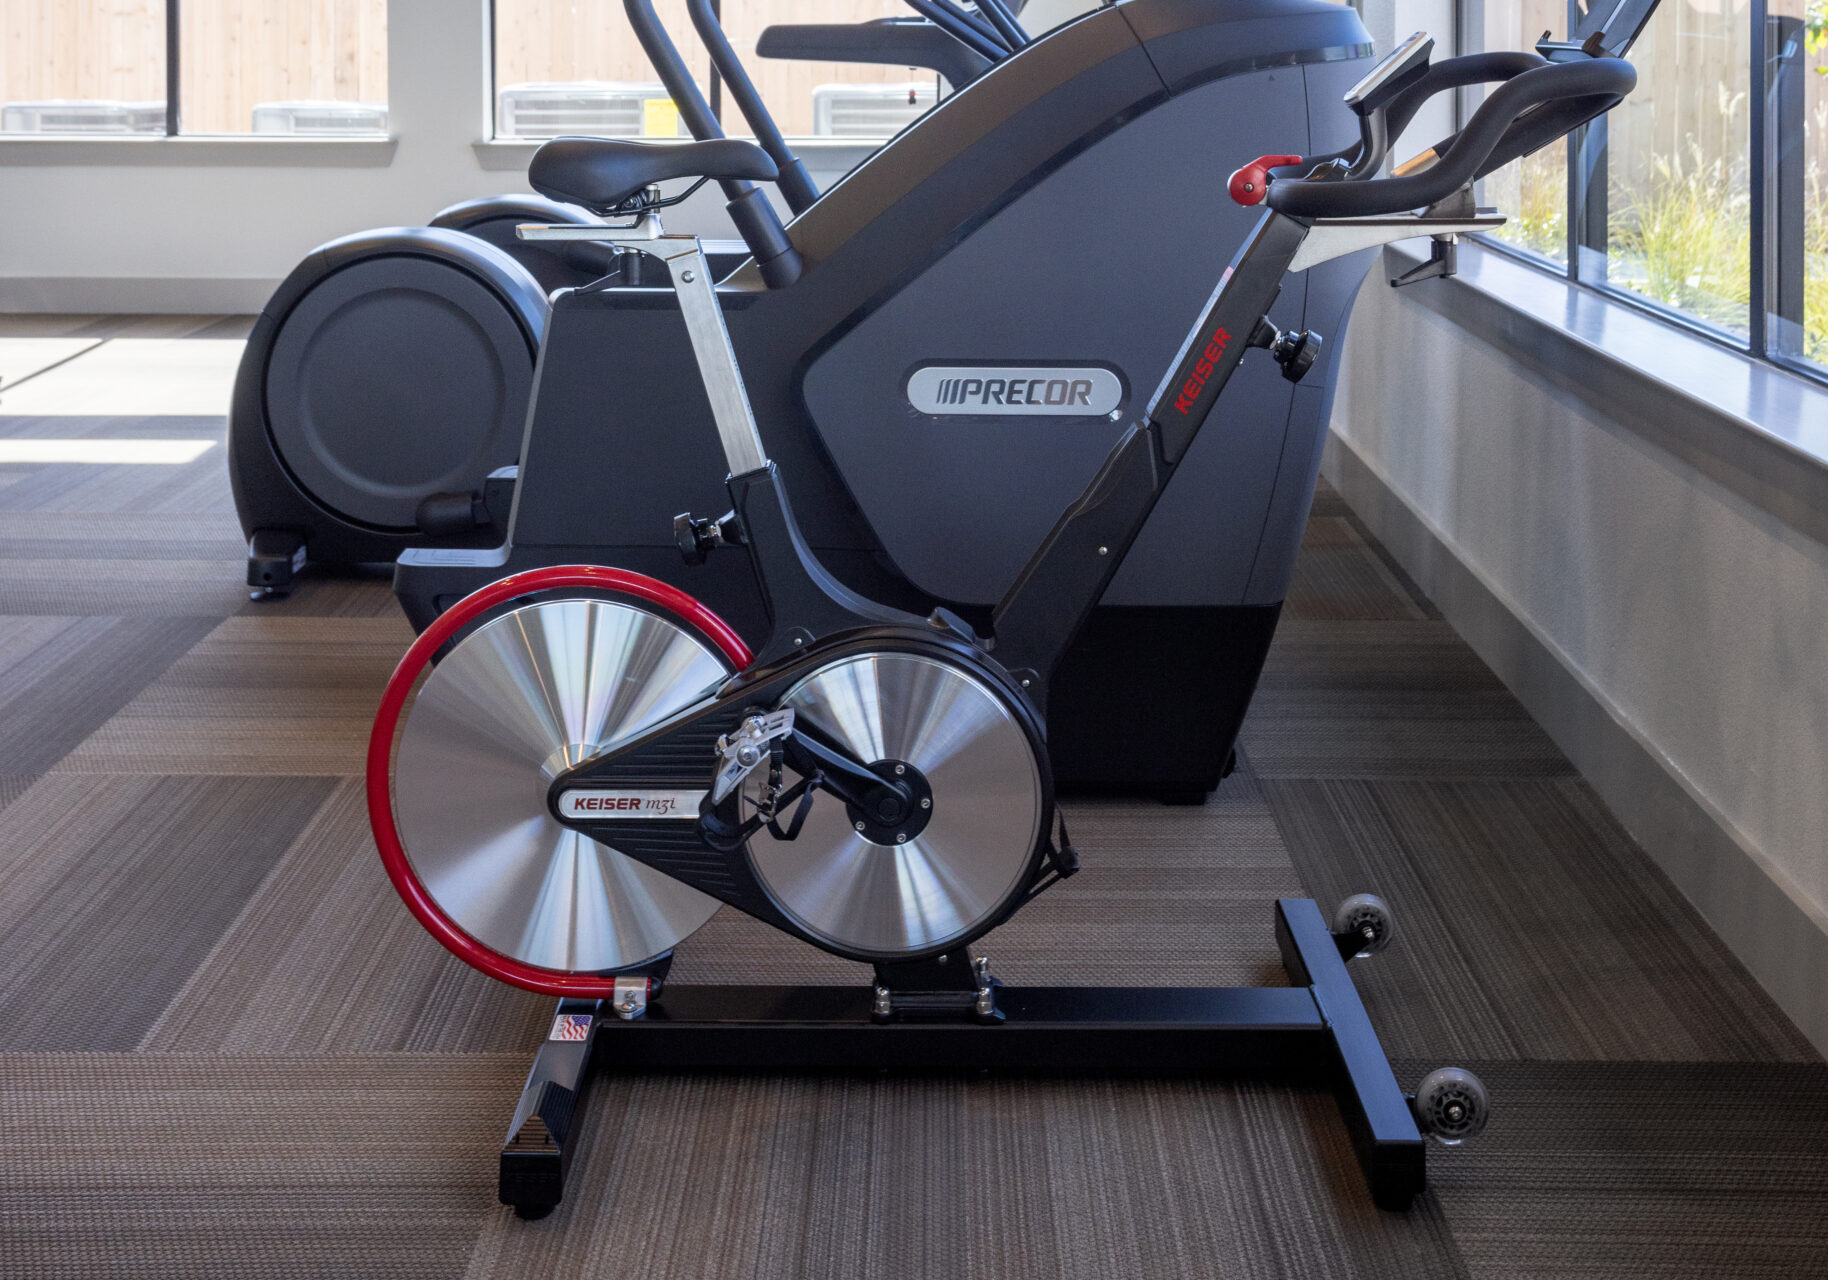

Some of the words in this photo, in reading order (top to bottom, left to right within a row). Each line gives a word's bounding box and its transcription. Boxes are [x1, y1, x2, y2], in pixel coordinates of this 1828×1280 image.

[1174, 327, 1232, 415] KEISER
[960, 378, 1093, 406] PRECOR
[574, 797, 642, 811] KEISER
